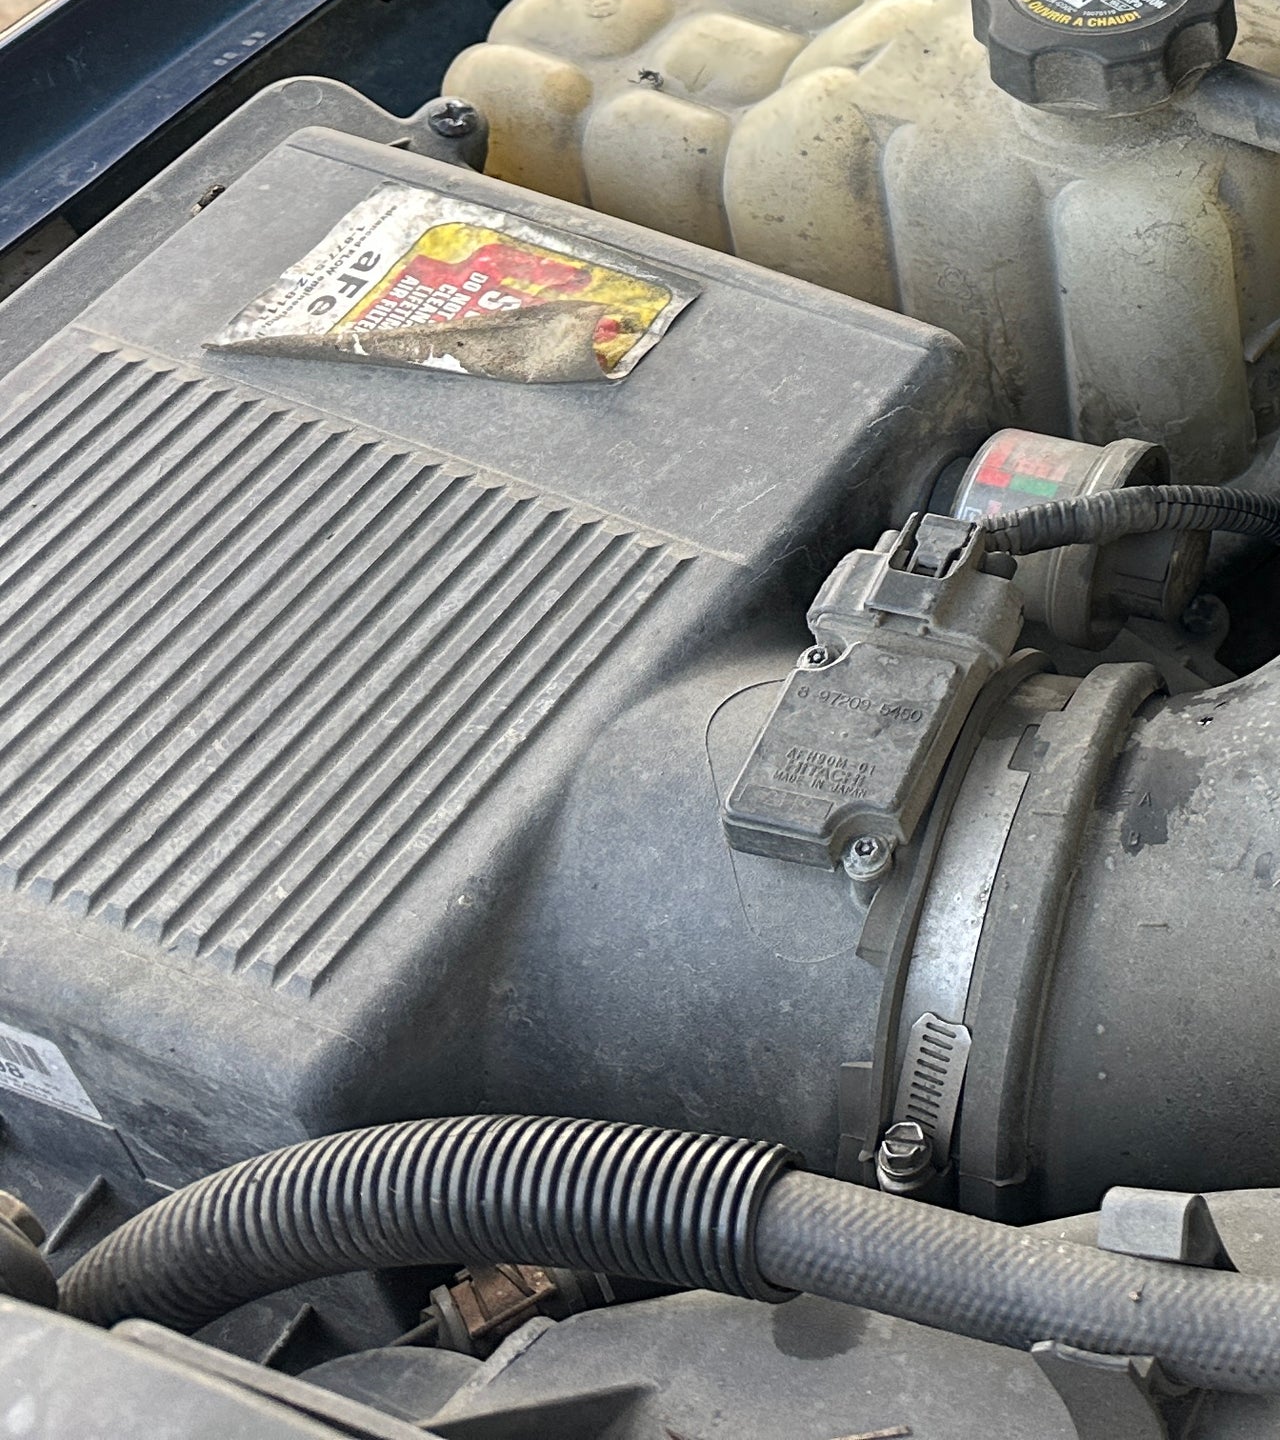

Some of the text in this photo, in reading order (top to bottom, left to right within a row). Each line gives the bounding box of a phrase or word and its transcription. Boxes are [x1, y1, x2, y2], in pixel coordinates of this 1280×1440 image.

[1028, 1, 1072, 25] OUVRIR
[1087, 11, 1141, 27] CHAUD!
[354, 205, 398, 247] advanced
[326, 249, 355, 276] FLOW
[307, 250, 381, 316] aFe
[389, 274, 420, 299] AIR
[437, 272, 489, 321] DO NOT
[377, 285, 434, 330] LIFETIM
[402, 283, 458, 328] CLEAN
[797, 686, 810, 698] 8
[819, 690, 872, 711] 97209
[772, 769, 868, 799] MADE IN JAPAN
[785, 759, 866, 787] HITACHI
